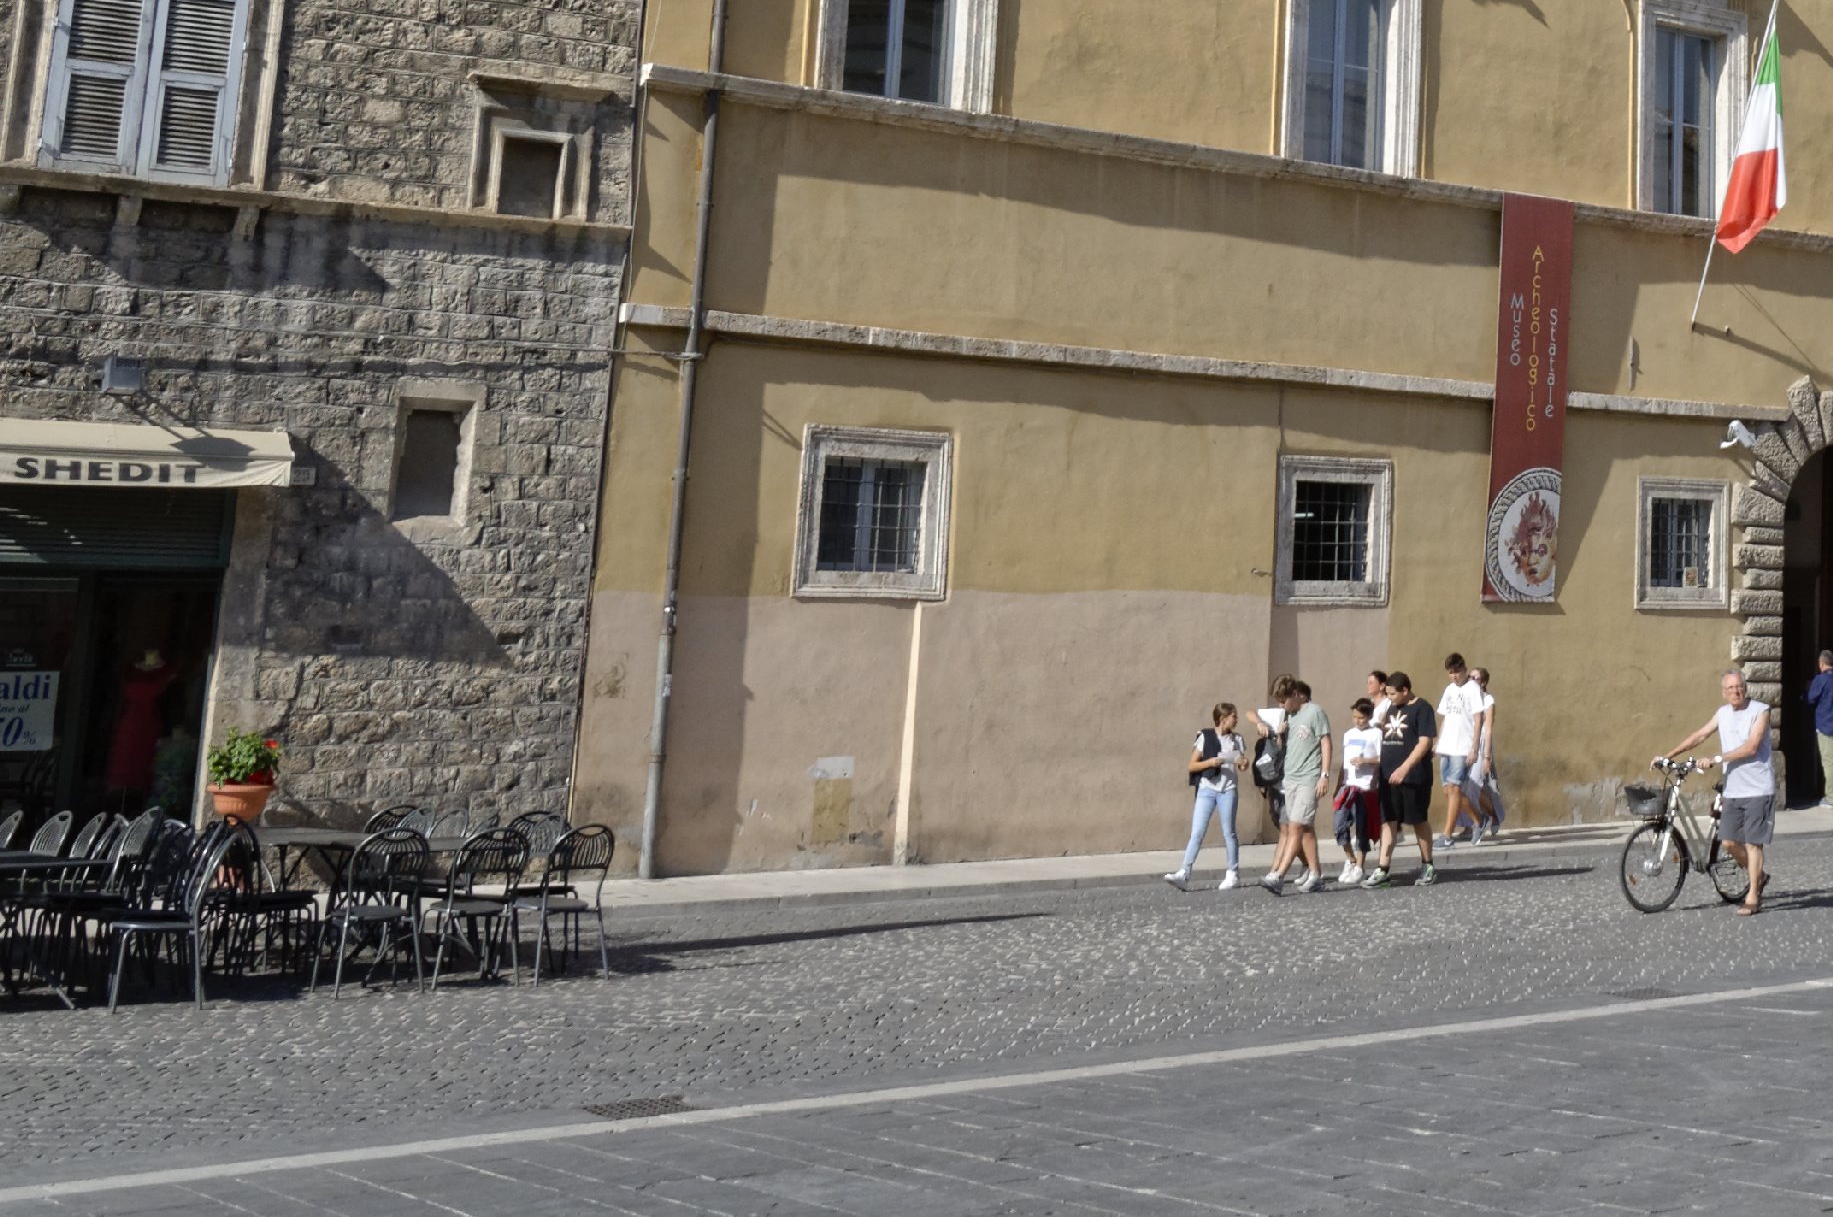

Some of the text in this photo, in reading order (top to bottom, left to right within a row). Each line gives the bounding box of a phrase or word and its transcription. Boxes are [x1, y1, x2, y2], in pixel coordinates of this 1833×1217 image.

[1510, 293, 1525, 366] Museo
[1526, 245, 1545, 431] Archeologico
[1544, 308, 1558, 418] Statale
[14, 456, 207, 483] SHEDIT
